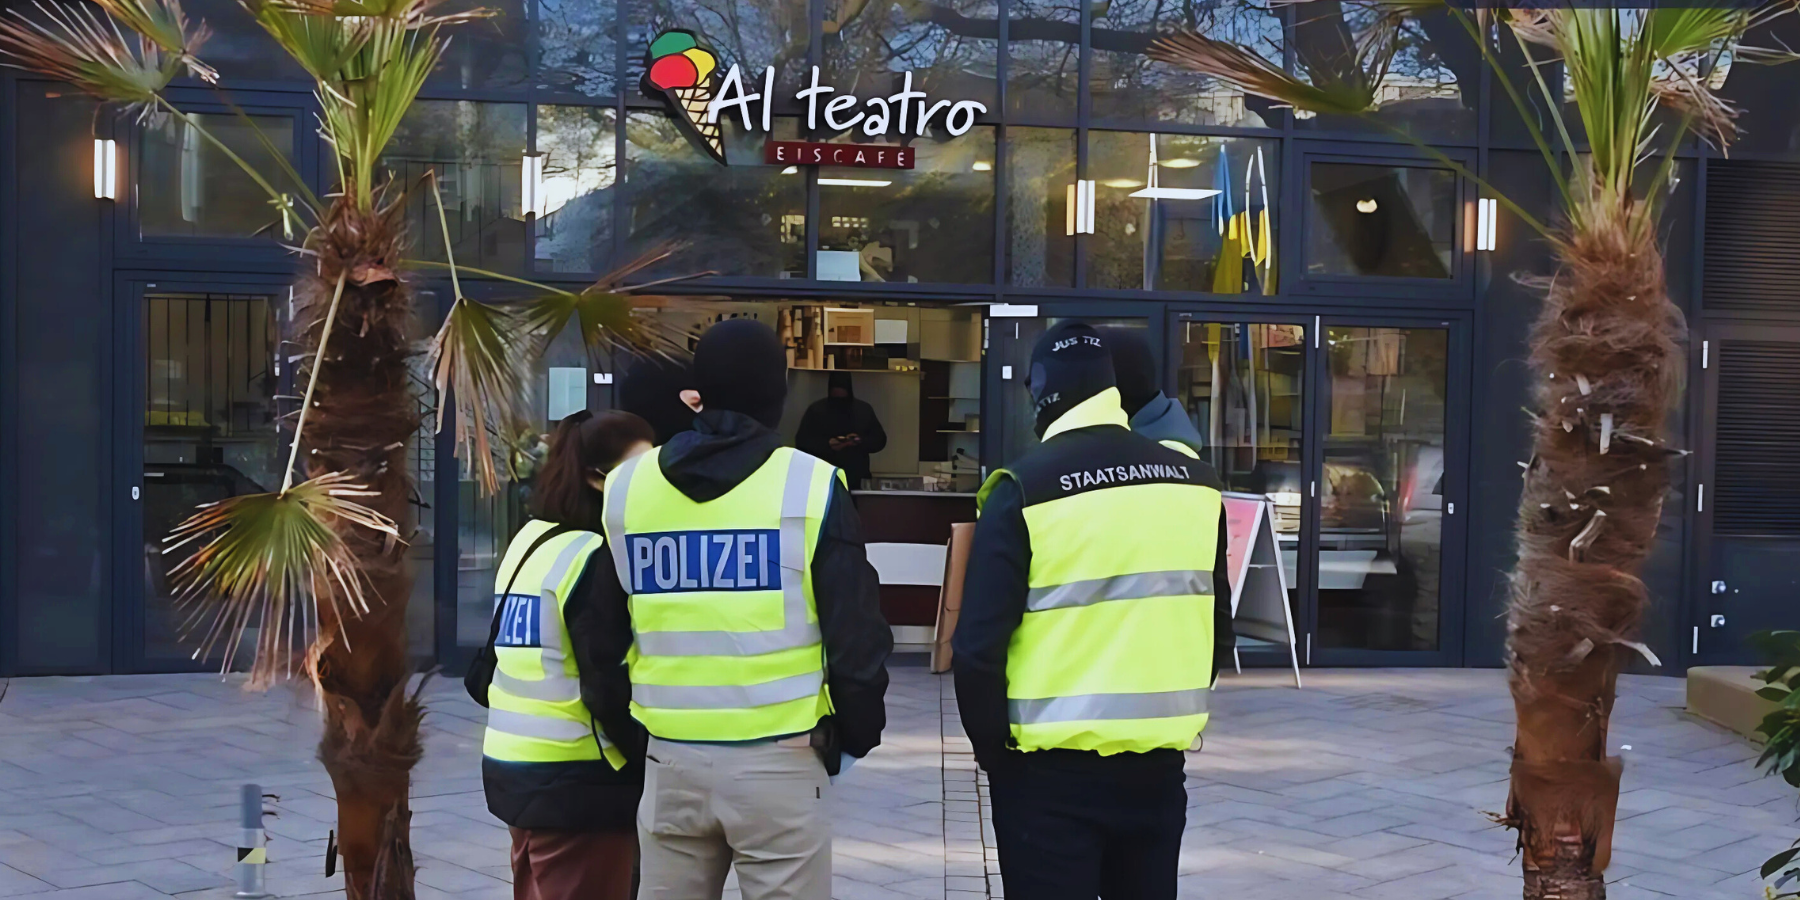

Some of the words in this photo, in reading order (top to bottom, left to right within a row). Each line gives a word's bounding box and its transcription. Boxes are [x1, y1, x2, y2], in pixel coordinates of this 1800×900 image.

[708, 63, 775, 131] Al
[795, 65, 988, 137] teatro
[776, 146, 905, 167] EISCAFÉ
[1060, 464, 1190, 491] STAATSANWALT
[633, 533, 769, 590] POLIZEI
[495, 596, 533, 645] IZEI
